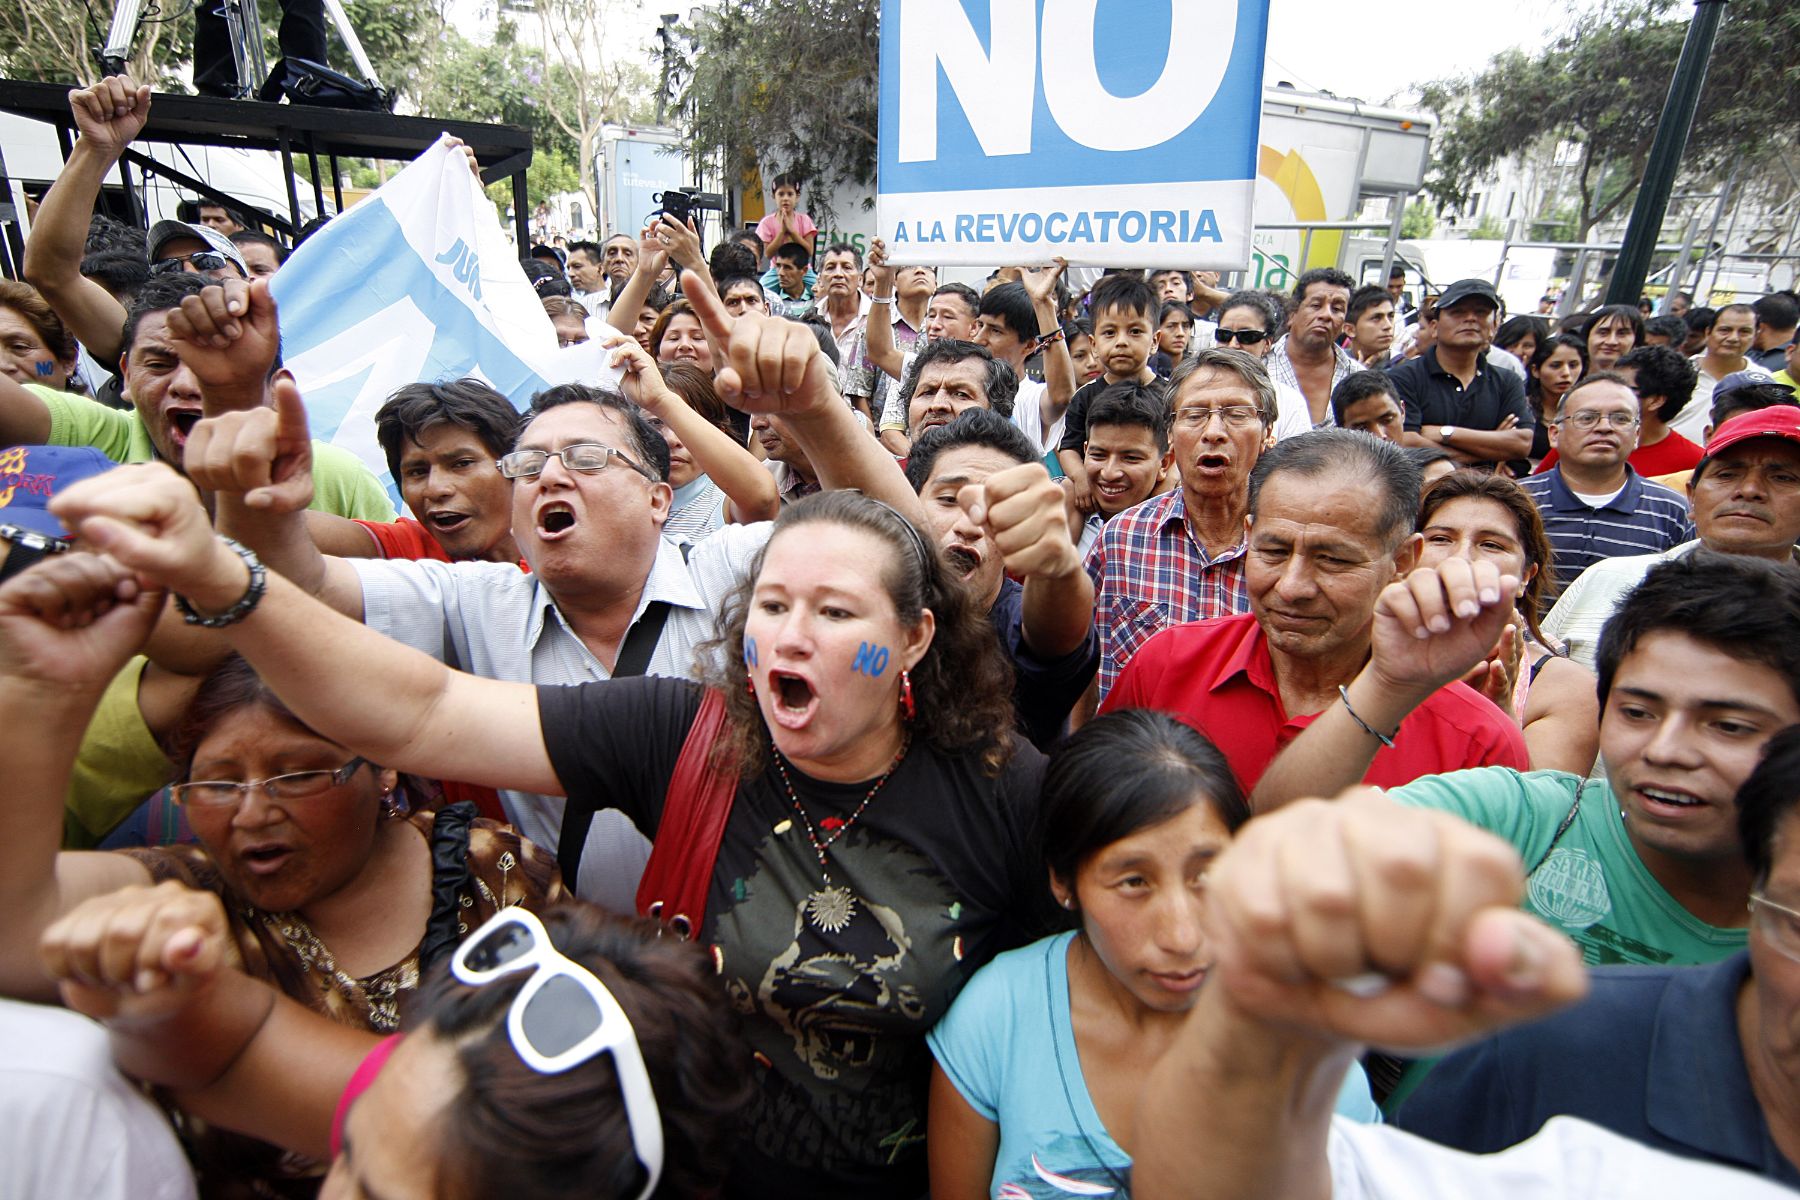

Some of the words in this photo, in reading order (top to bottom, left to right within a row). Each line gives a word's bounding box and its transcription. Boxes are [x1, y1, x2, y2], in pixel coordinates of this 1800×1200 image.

[899, 0, 1239, 163] NO
[894, 221, 909, 243] A
[917, 221, 946, 243] LA
[954, 209, 1223, 244] REVOCATORIA
[35, 360, 54, 376] NO
[851, 640, 889, 678] NO
